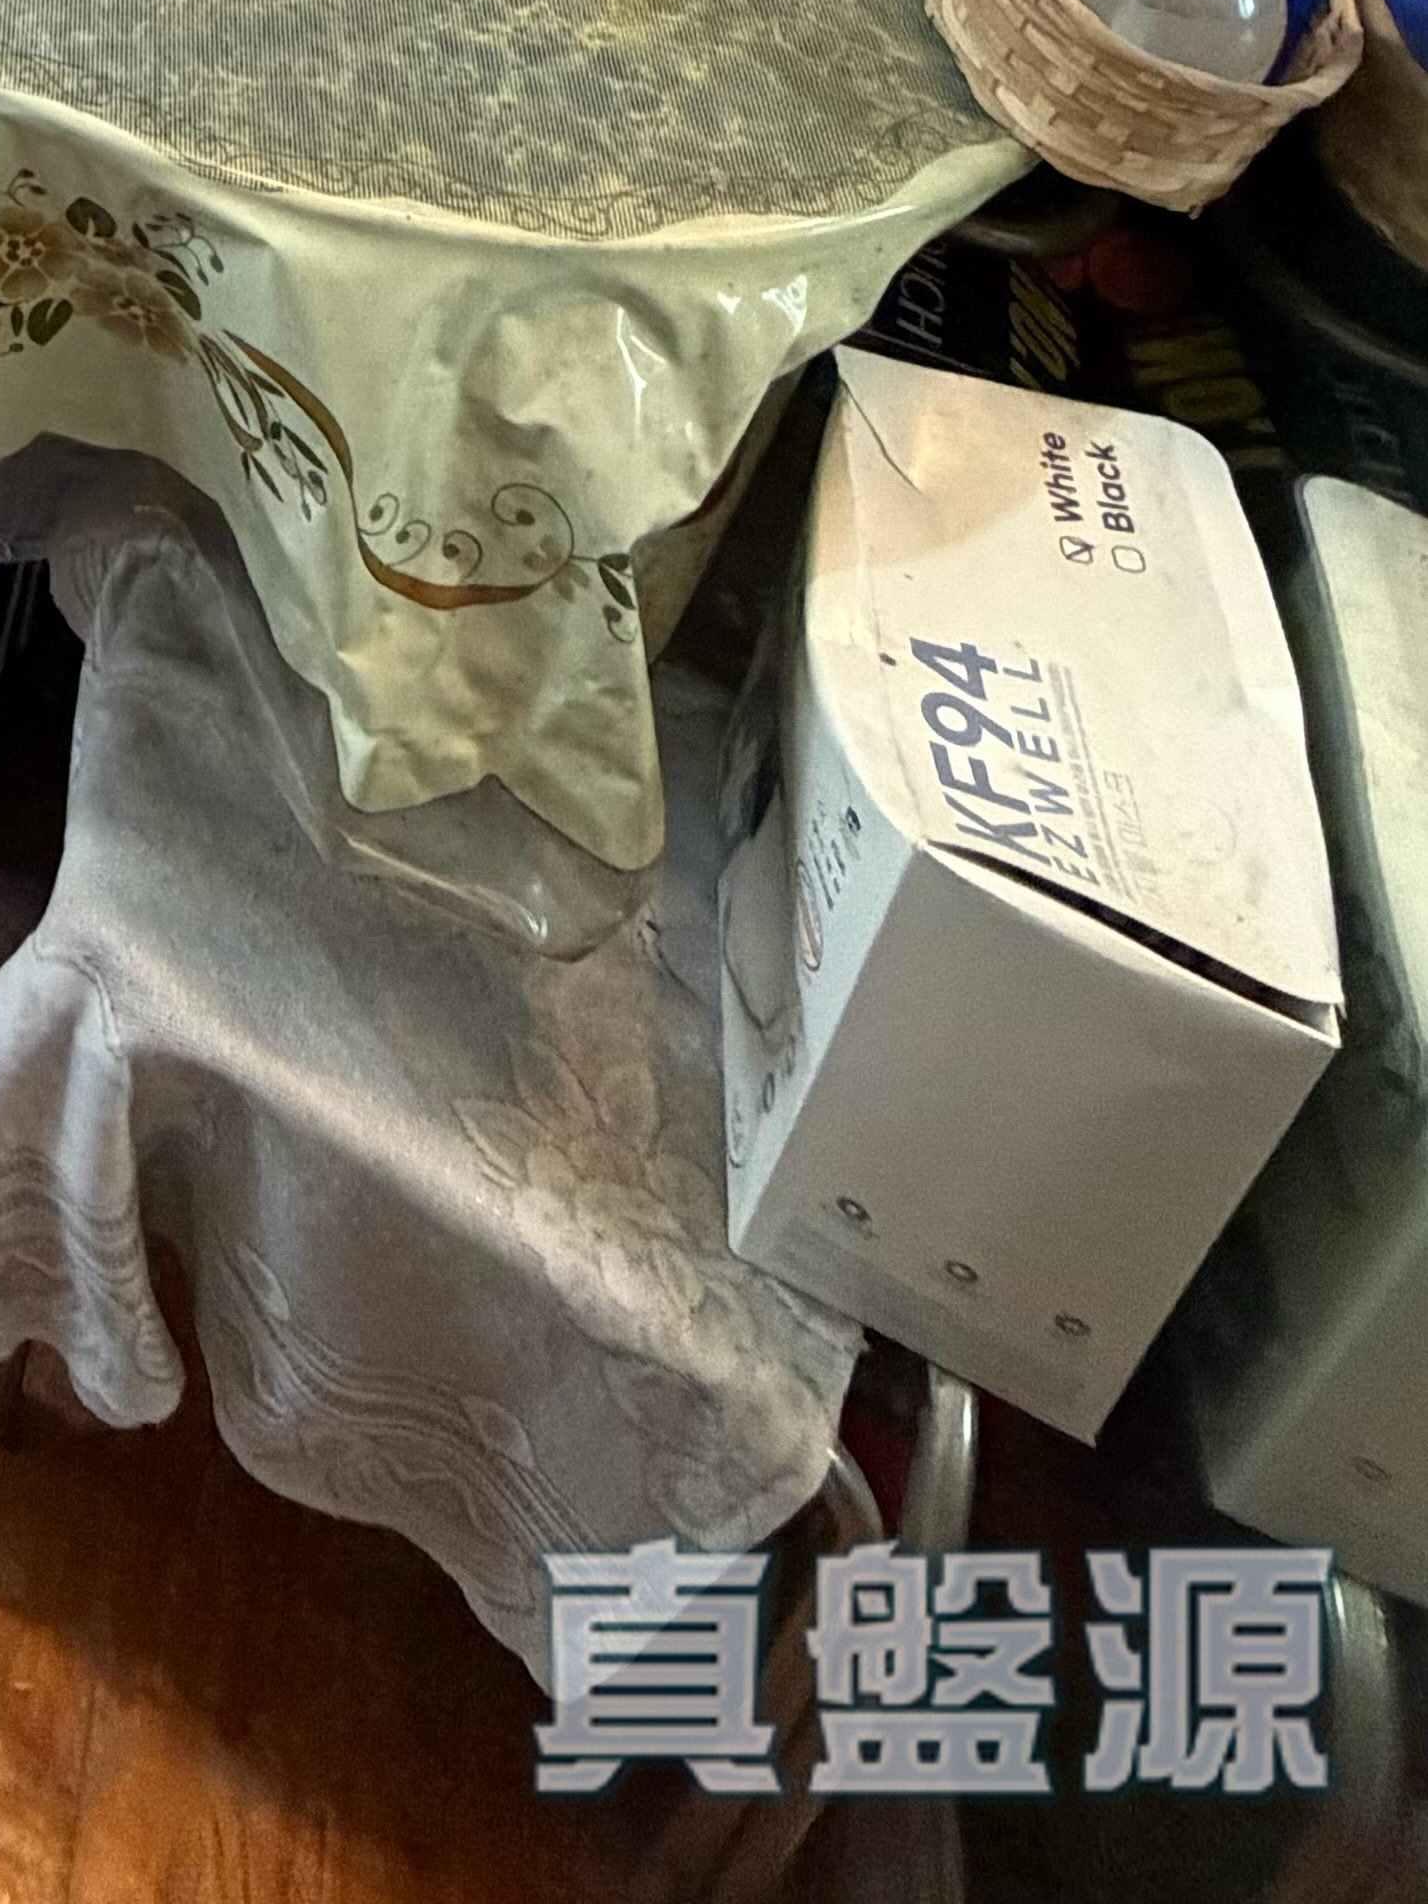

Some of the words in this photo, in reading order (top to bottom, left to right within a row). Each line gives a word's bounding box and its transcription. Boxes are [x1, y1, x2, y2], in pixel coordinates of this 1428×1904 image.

[1041, 430, 1087, 524] White
[1092, 440, 1136, 535] Black
[909, 636, 1052, 868] KF94
